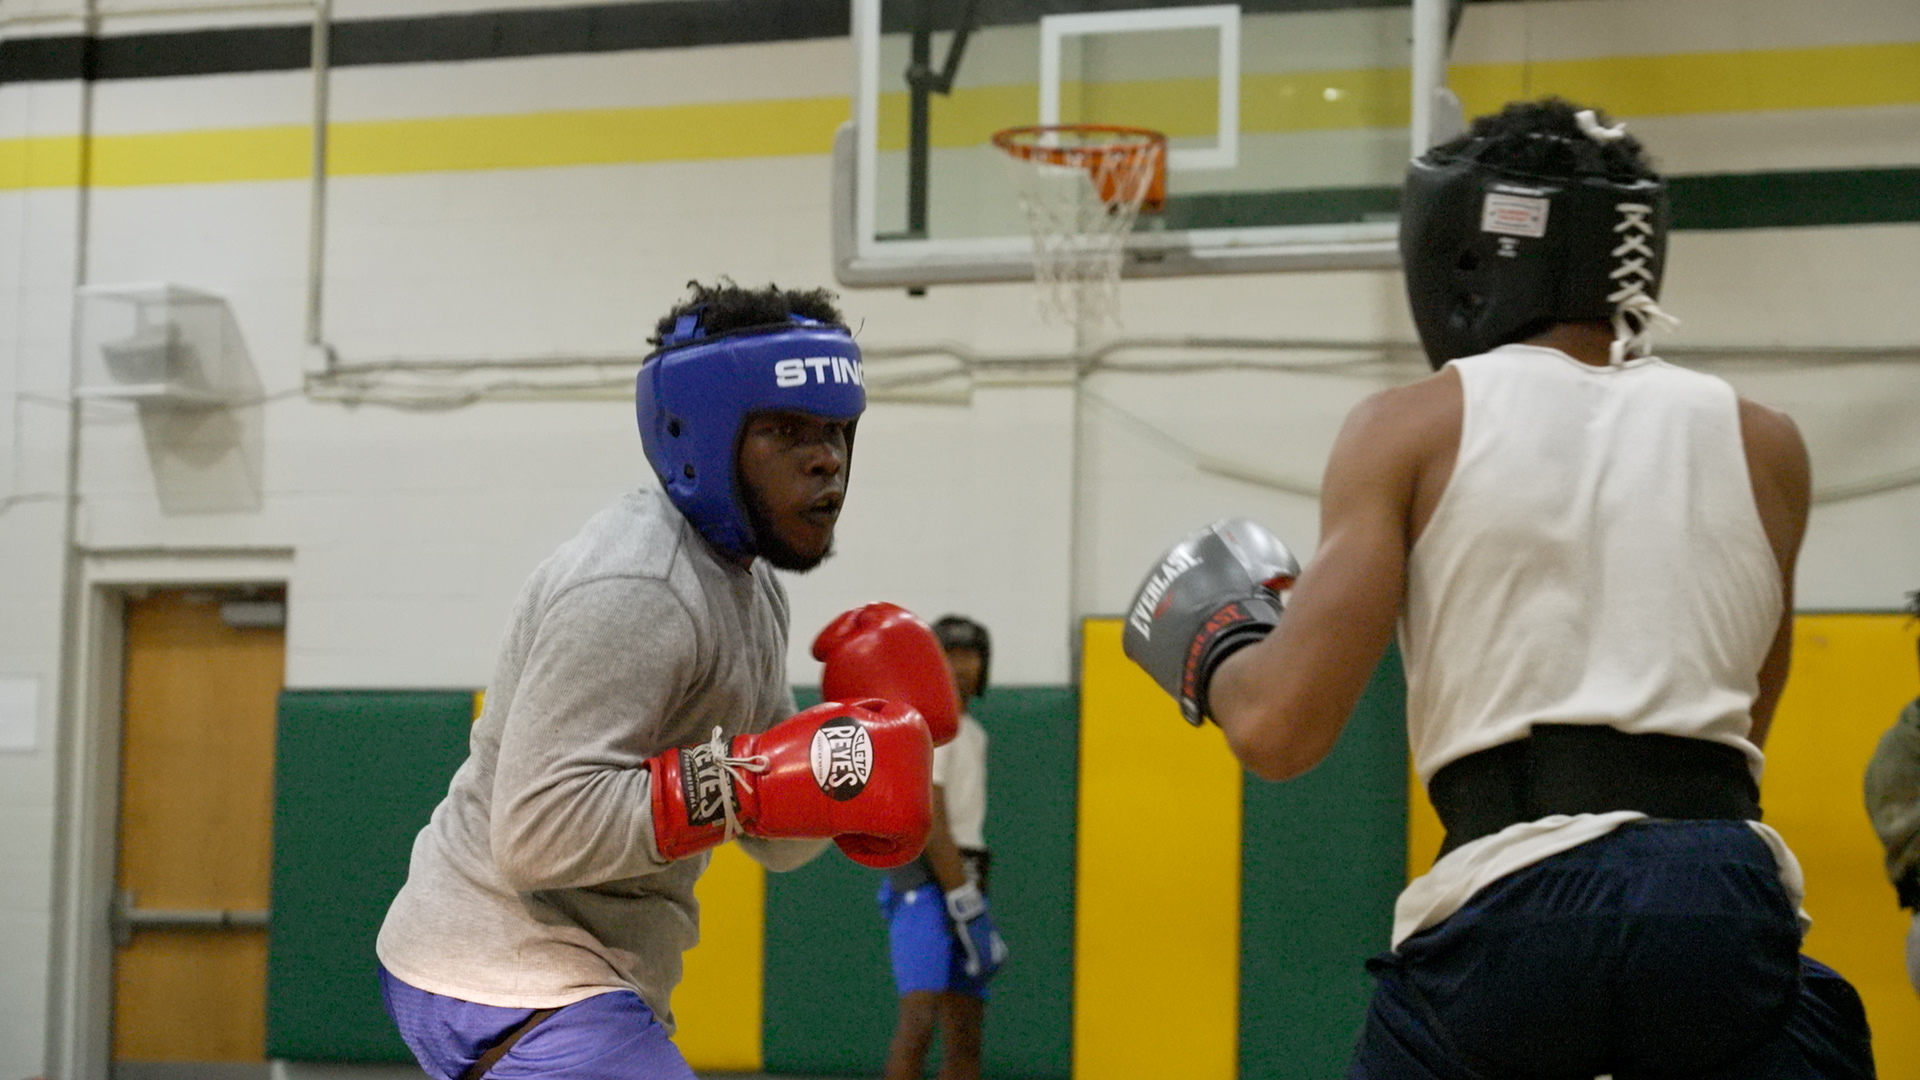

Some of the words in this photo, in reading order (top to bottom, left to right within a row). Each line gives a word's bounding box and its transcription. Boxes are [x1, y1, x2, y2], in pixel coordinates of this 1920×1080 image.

[1129, 541, 1200, 641] EVERLAST
[821, 725, 858, 788] REYES
[854, 733, 867, 777] CLETO
